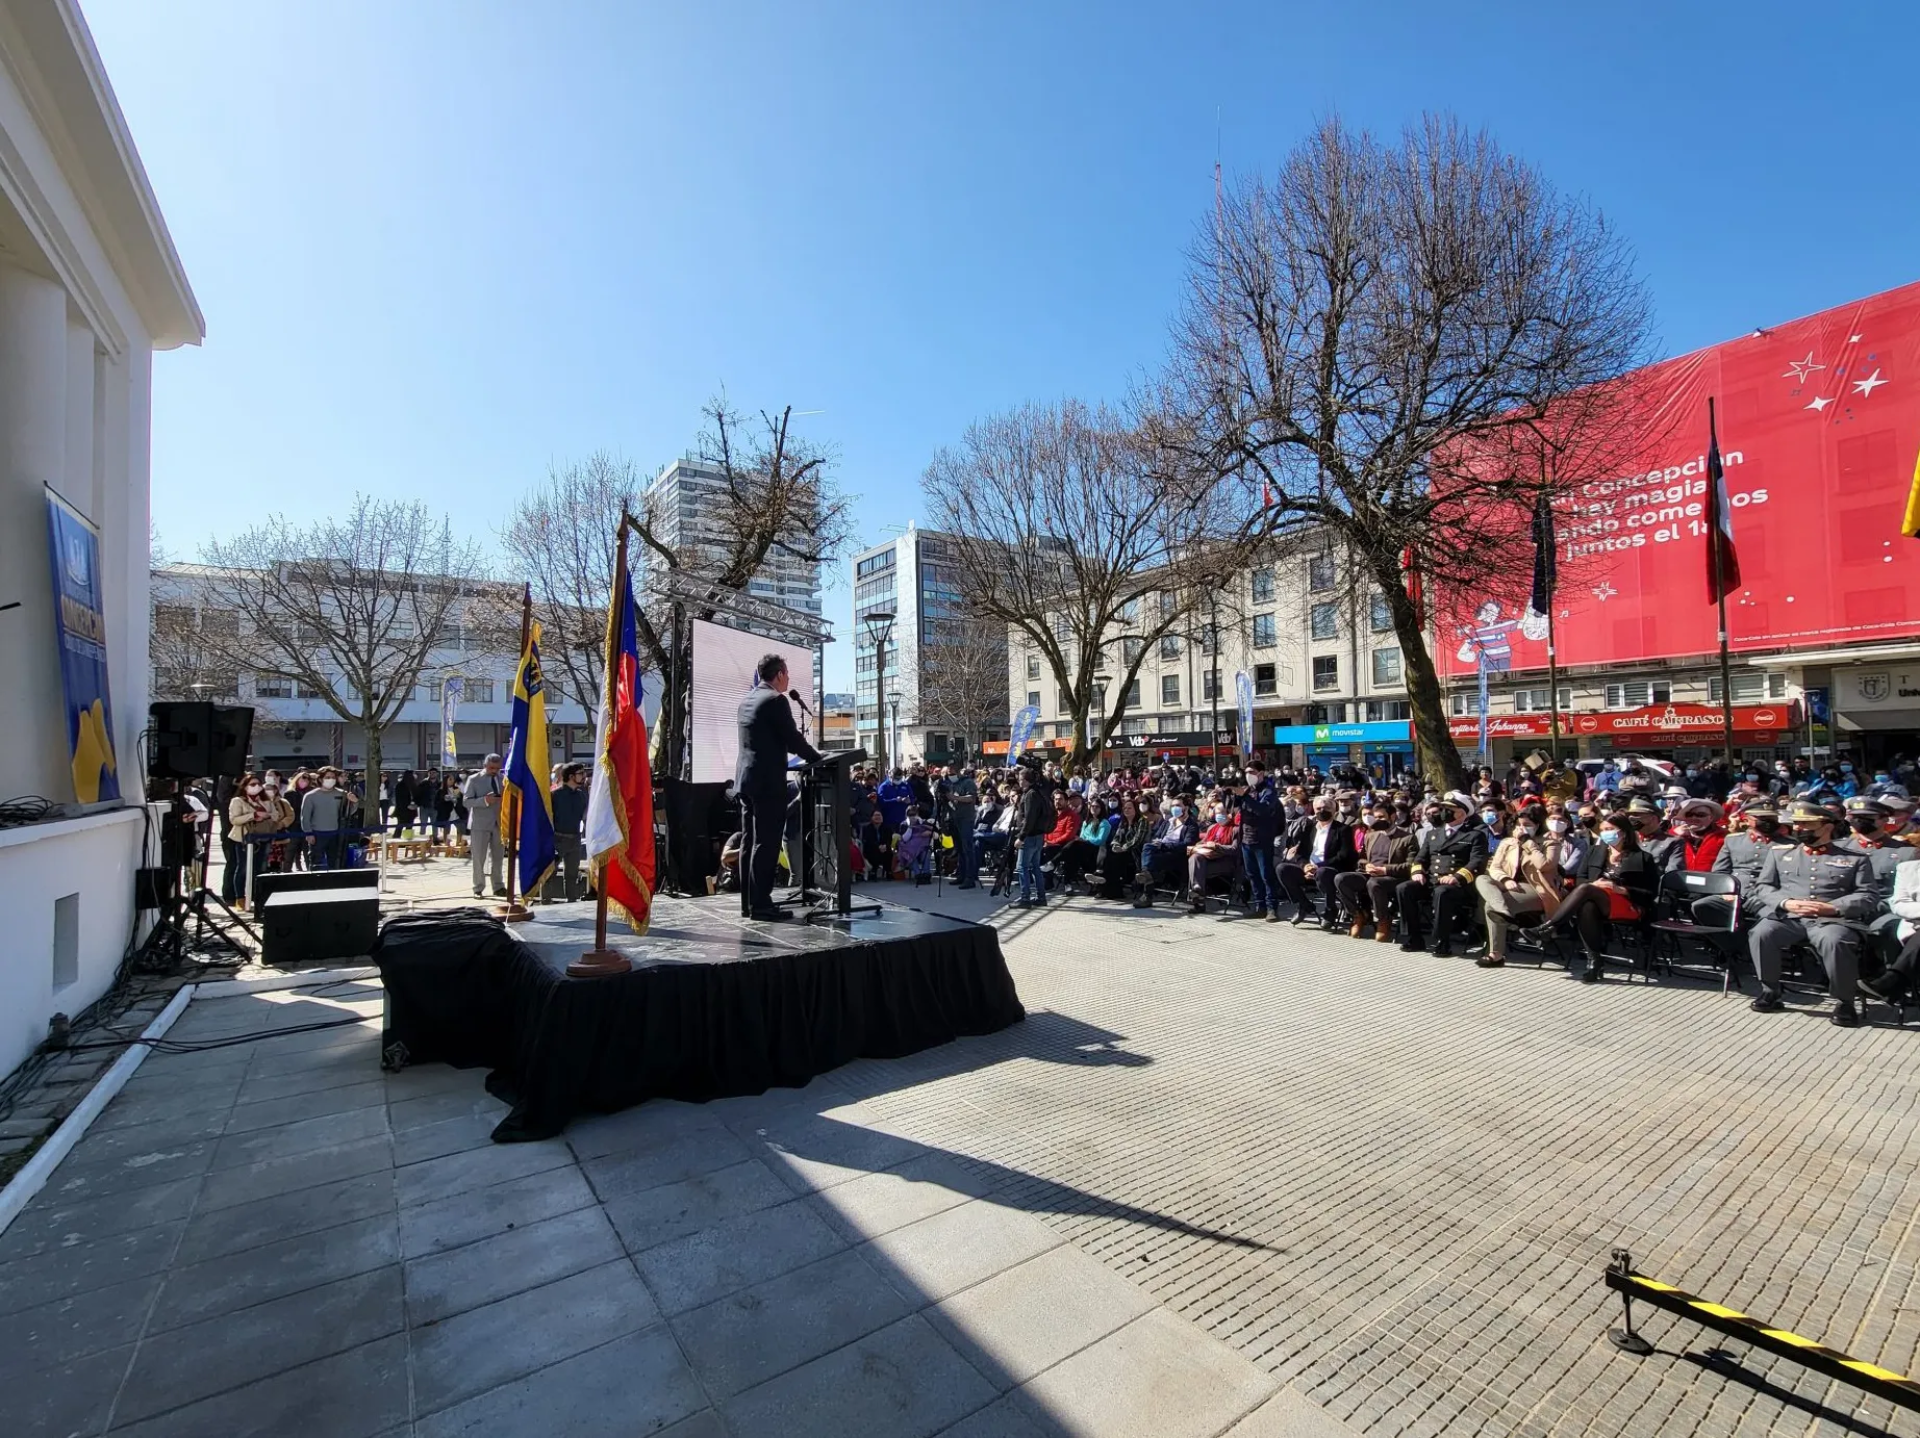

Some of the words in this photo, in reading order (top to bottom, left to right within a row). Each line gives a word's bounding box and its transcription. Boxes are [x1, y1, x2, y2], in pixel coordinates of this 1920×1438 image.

[1624, 479, 1707, 509] magia
[1626, 488, 1769, 526] comeos
[1565, 531, 1646, 562] juntos
[1654, 525, 1681, 543] el
[1487, 719, 1529, 735] Johanna
[1613, 714, 1650, 727] CAFÉ
[1652, 713, 1735, 726] CARRASC
[1332, 728, 1364, 737] movistar
